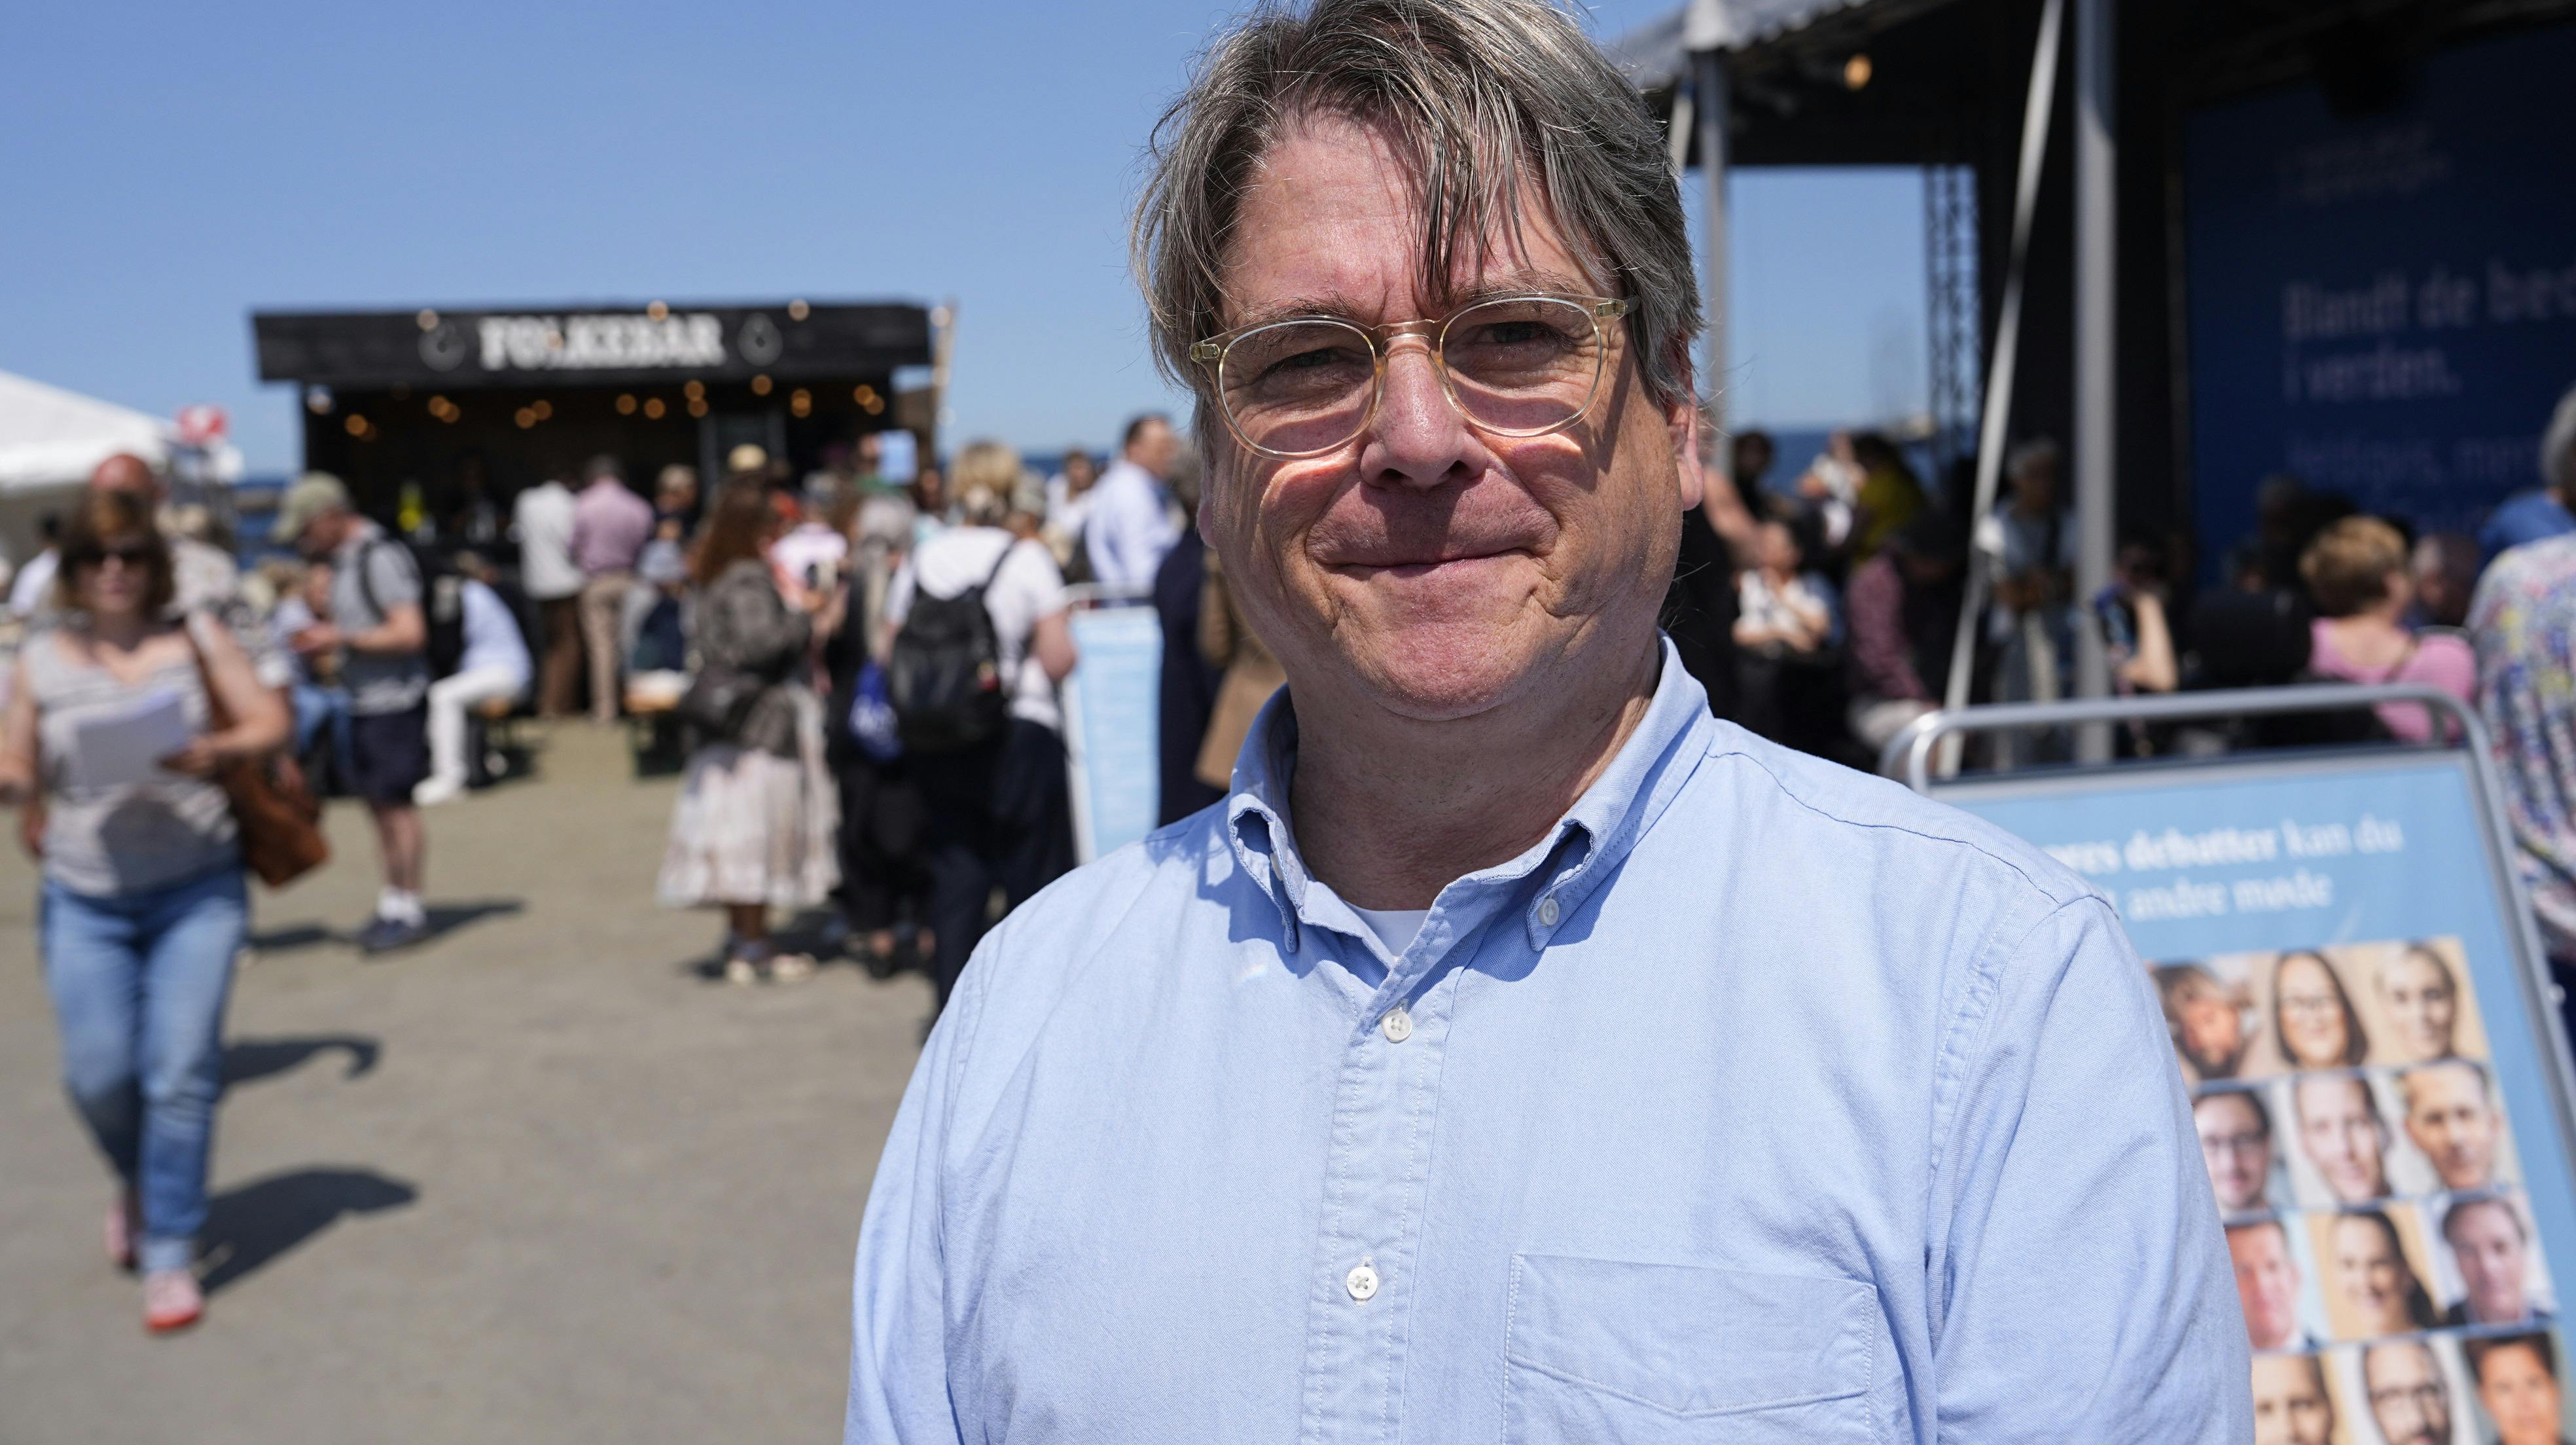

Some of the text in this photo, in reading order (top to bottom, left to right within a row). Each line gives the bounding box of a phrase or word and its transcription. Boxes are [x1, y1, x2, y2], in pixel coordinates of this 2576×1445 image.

[2283, 268, 2408, 340] Blandt
[2419, 263, 2475, 327] de
[479, 317, 724, 368] FOLKEBAR
[2124, 827, 2278, 871] debatter
[2280, 818, 2352, 859] kan
[2353, 812, 2405, 855] du
[2126, 876, 2230, 922] andre
